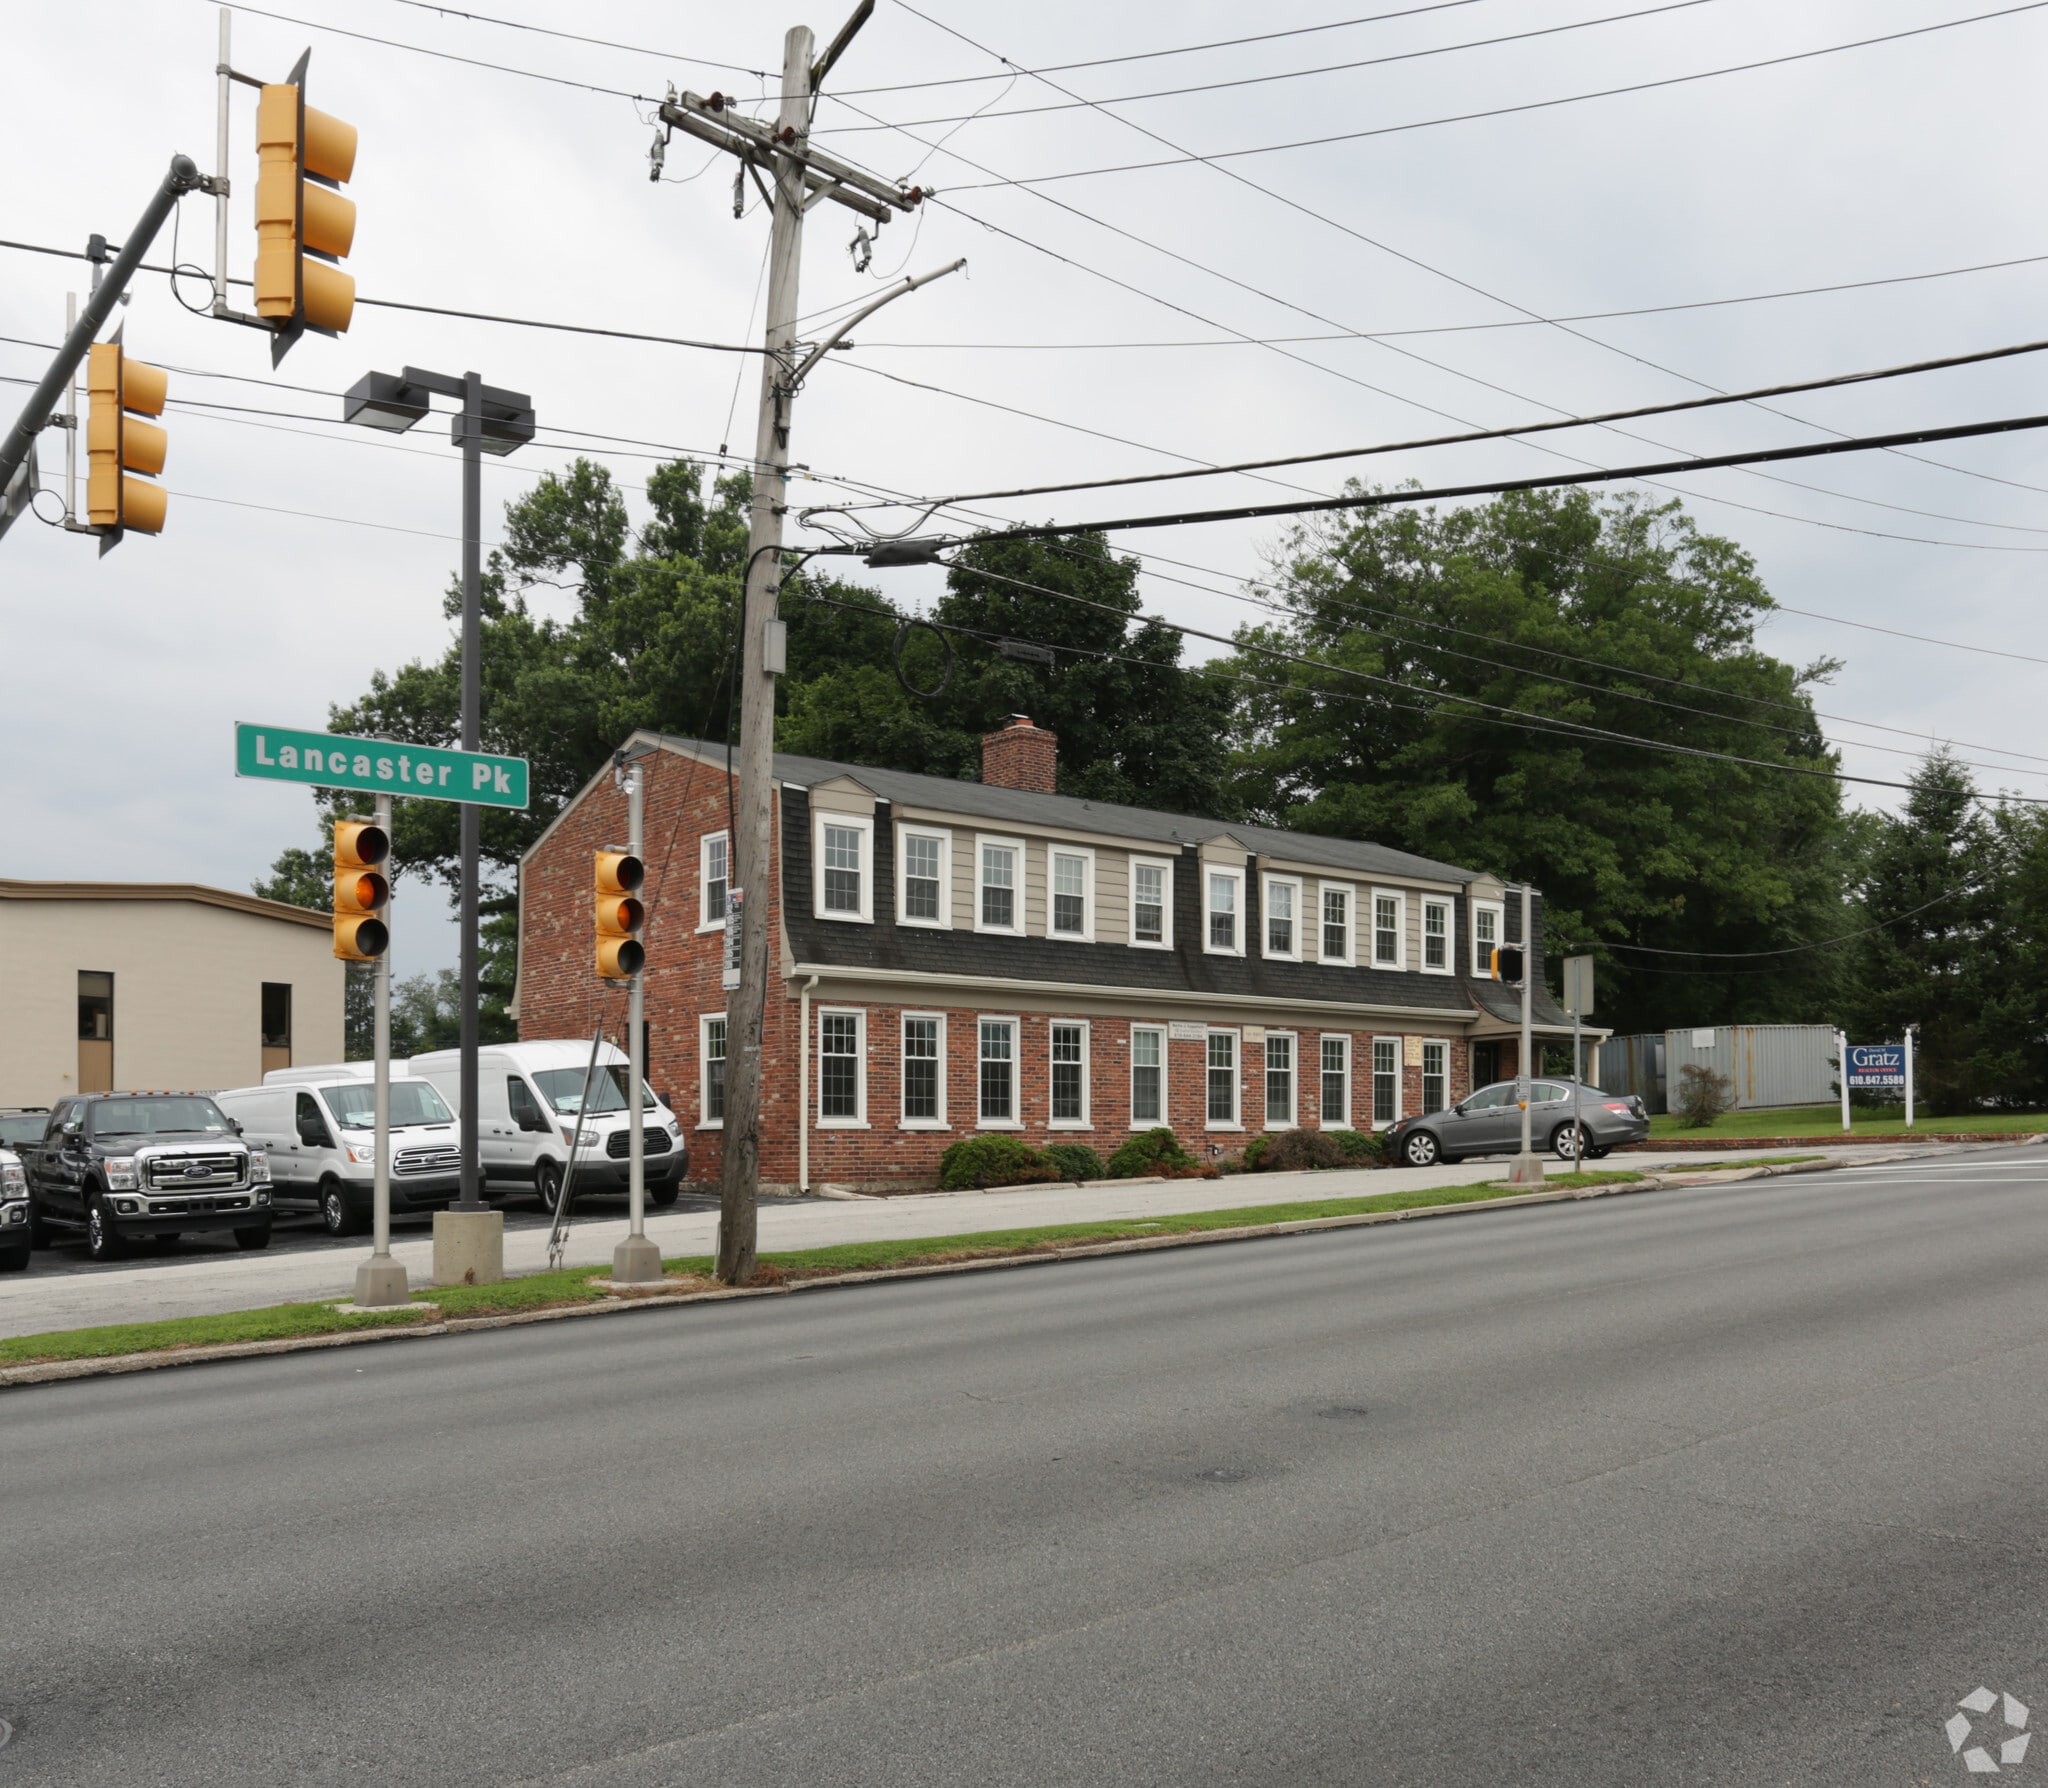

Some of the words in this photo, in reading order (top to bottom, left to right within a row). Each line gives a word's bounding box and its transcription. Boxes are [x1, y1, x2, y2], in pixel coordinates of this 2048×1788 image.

[256, 735, 451, 786] Lancaster
[472, 763, 511, 793] Pk
[1852, 1048, 1899, 1066] Gratz
[1849, 1075, 1904, 1085] 610.647.5588
